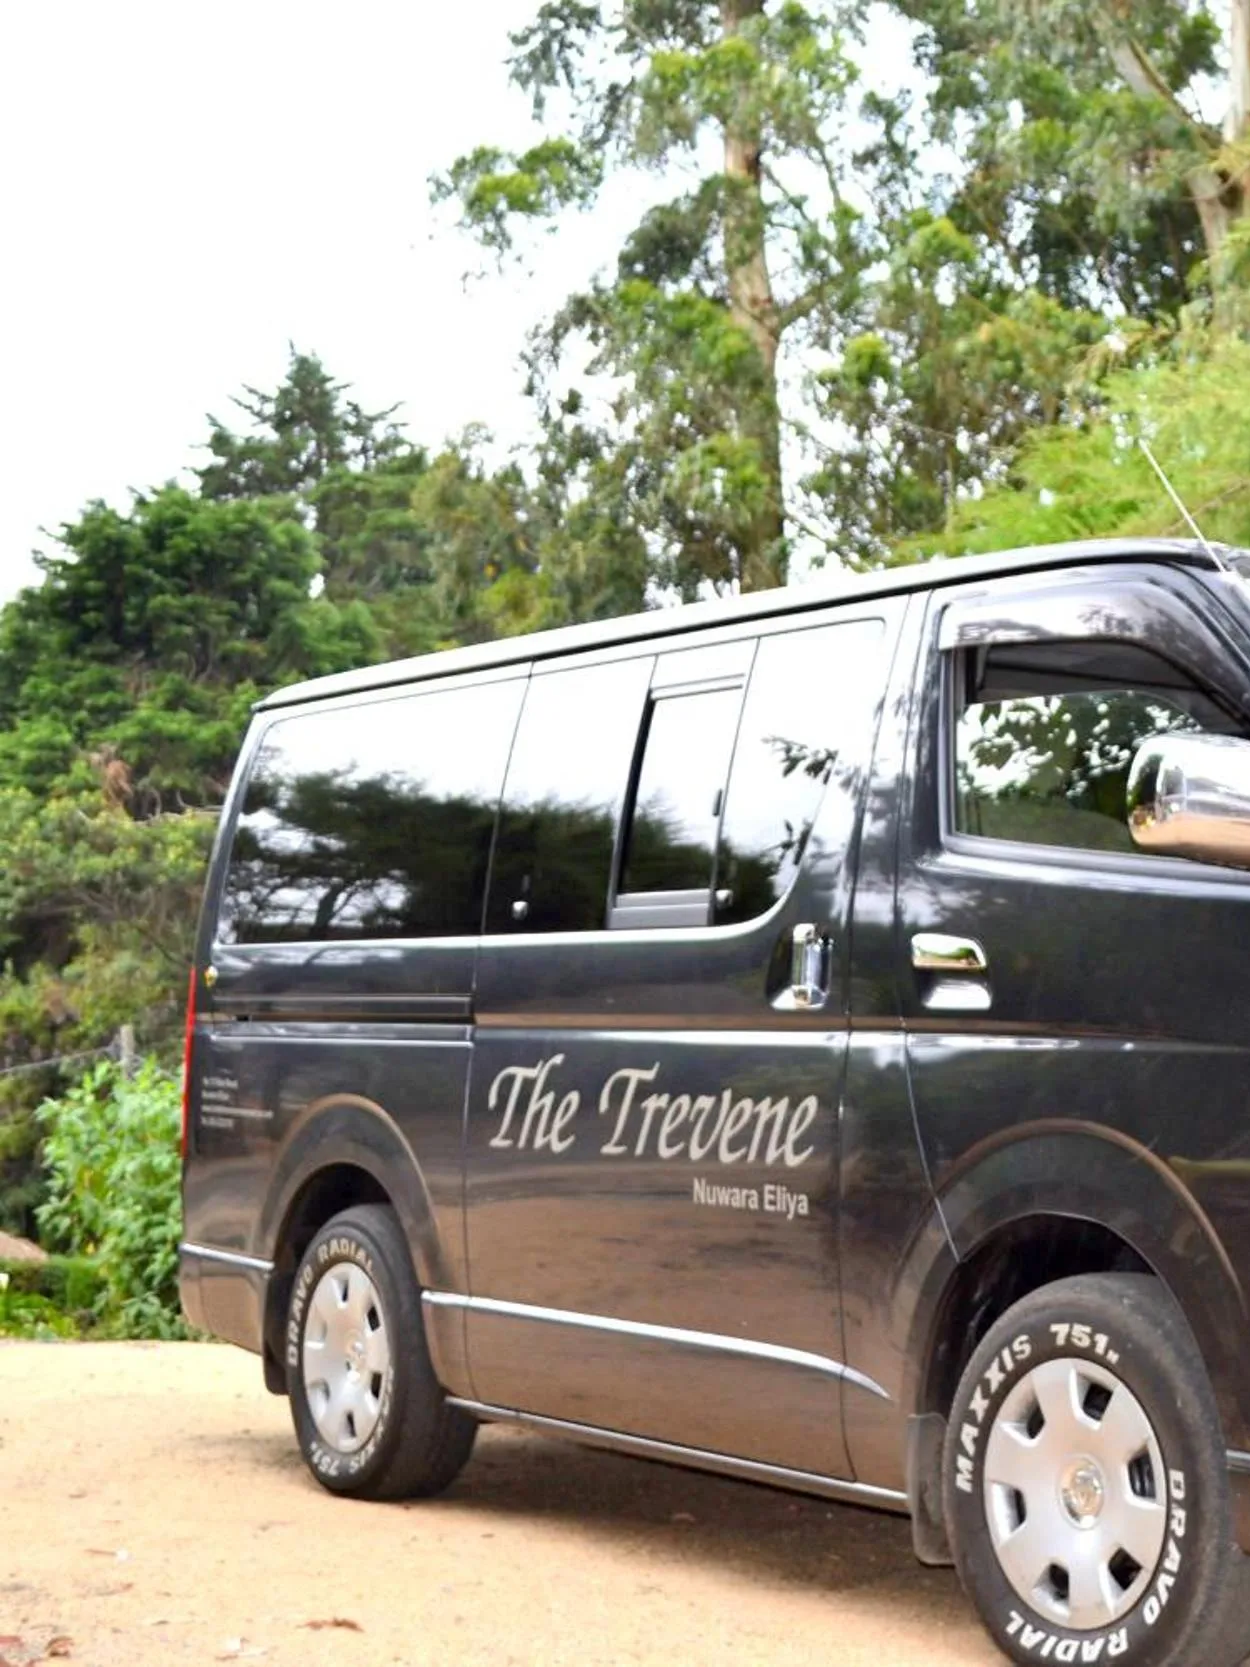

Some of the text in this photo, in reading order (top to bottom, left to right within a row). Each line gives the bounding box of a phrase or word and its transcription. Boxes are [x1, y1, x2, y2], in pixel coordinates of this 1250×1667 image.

[488, 1053, 818, 1167] The Trevene
[692, 1177, 809, 1220] Nuwara Eliya
[317, 1237, 374, 1273] RADIAL
[955, 1334, 1032, 1493] MAXXIS
[1004, 1610, 1130, 1663] RADIAL
